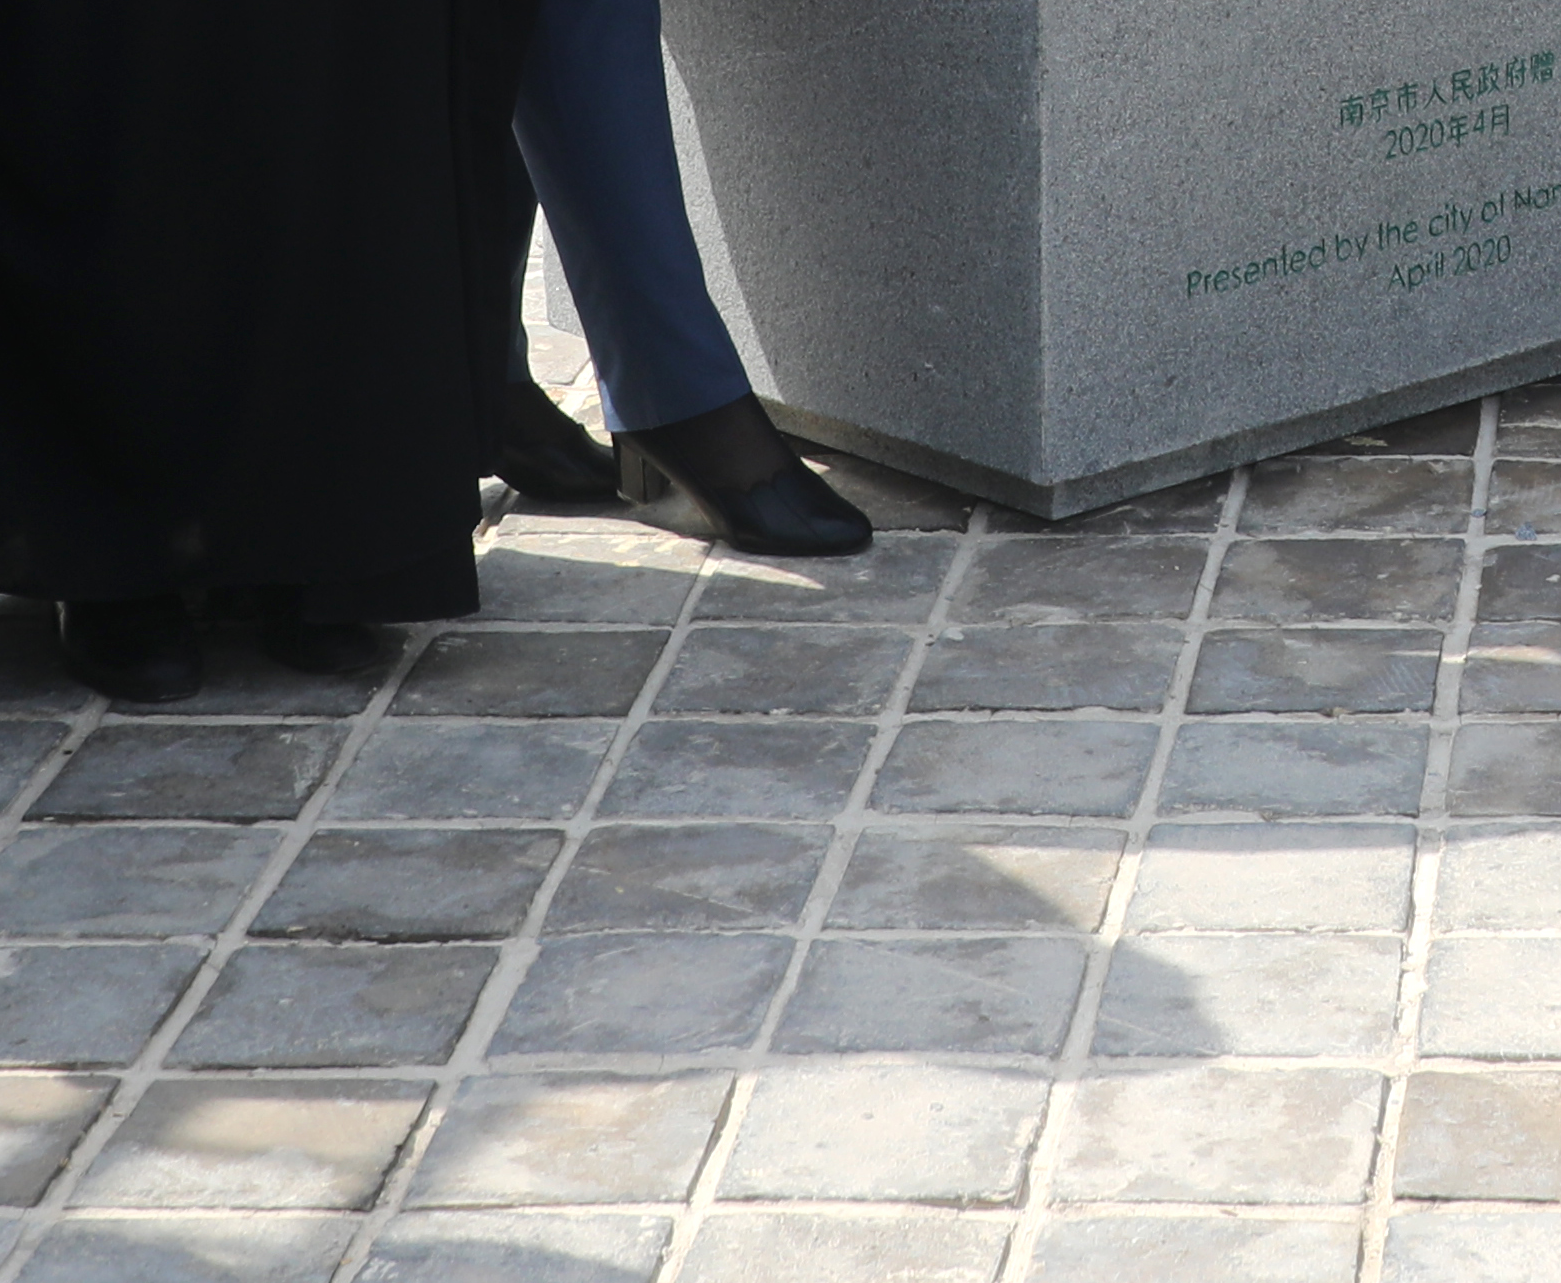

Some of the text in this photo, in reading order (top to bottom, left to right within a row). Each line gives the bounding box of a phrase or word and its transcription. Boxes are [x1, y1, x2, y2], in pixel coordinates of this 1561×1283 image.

[1340, 51, 1555, 128] 南京市人民政府赠
[1385, 104, 1510, 159] 2020年4月
[1186, 238, 1326, 300] Presented
[1335, 234, 1368, 262] by
[1377, 221, 1419, 251] the
[1429, 203, 1473, 237] city
[1481, 193, 1505, 223] of
[1389, 235, 1512, 293] April 2020
